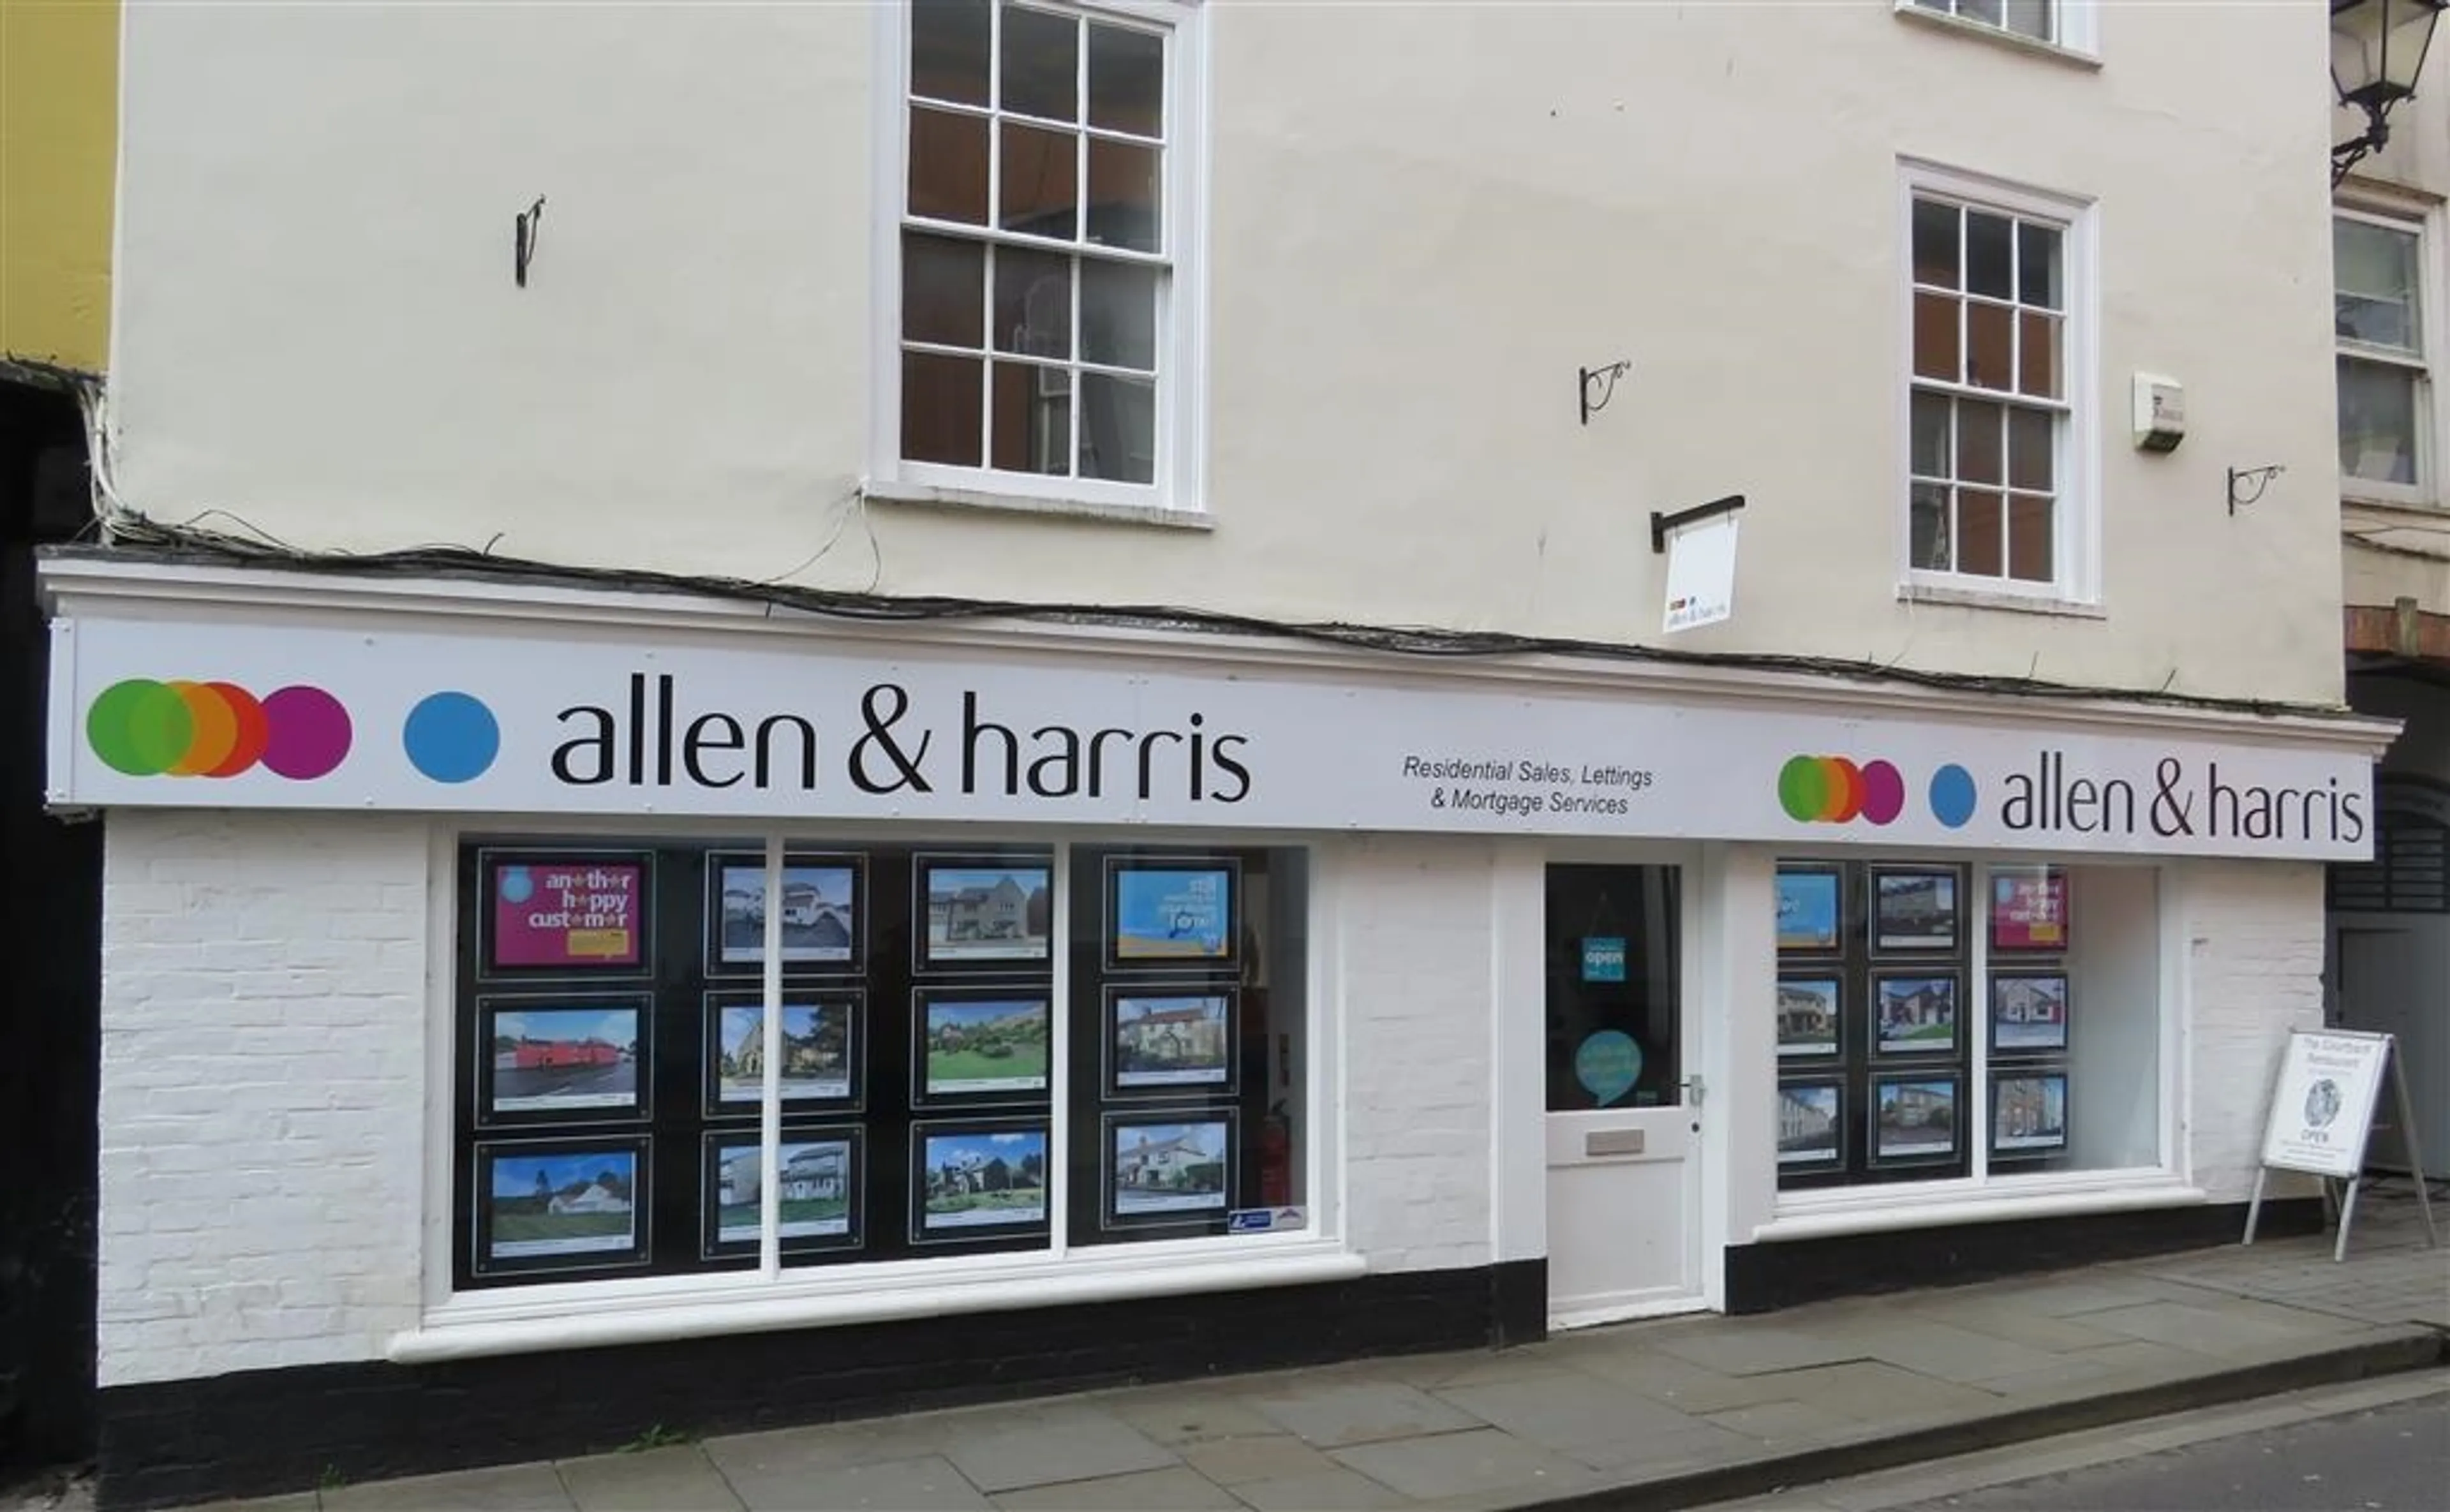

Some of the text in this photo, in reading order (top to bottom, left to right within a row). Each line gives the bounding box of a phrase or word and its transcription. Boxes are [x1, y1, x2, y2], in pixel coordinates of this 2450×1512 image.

[551, 672, 1251, 804] allen & harris
[1402, 755, 1654, 792] Residential Sales, Lettings
[1430, 786, 1629, 817] & Mortgage Services
[2001, 750, 2364, 844] allen & harris
[1585, 951, 1624, 968] open
